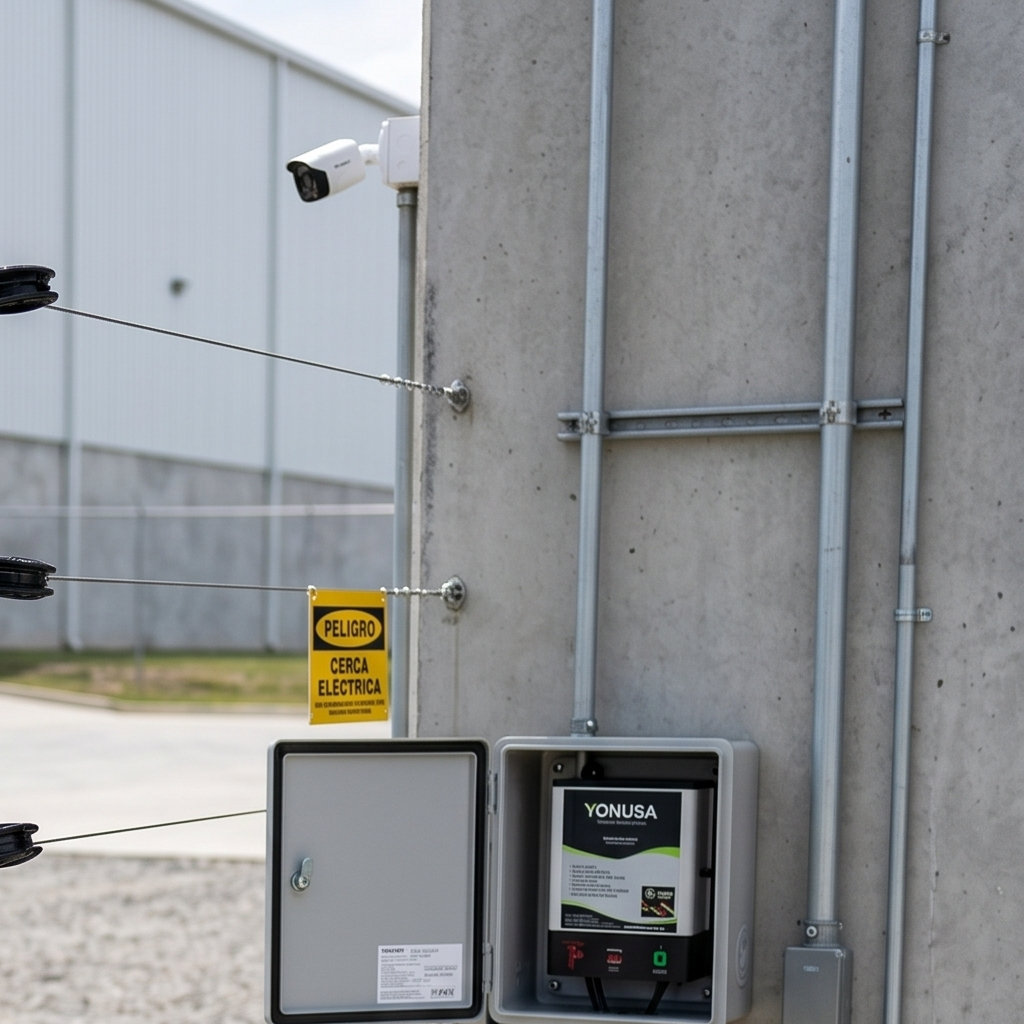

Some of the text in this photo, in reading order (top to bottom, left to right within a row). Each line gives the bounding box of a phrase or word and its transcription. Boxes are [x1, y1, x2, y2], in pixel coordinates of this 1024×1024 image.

[324, 619, 375, 638] PELIGRO
[330, 657, 369, 675] CERCA
[318, 678, 382, 697] ELECTRICA
[584, 802, 658, 819] YONUSA
